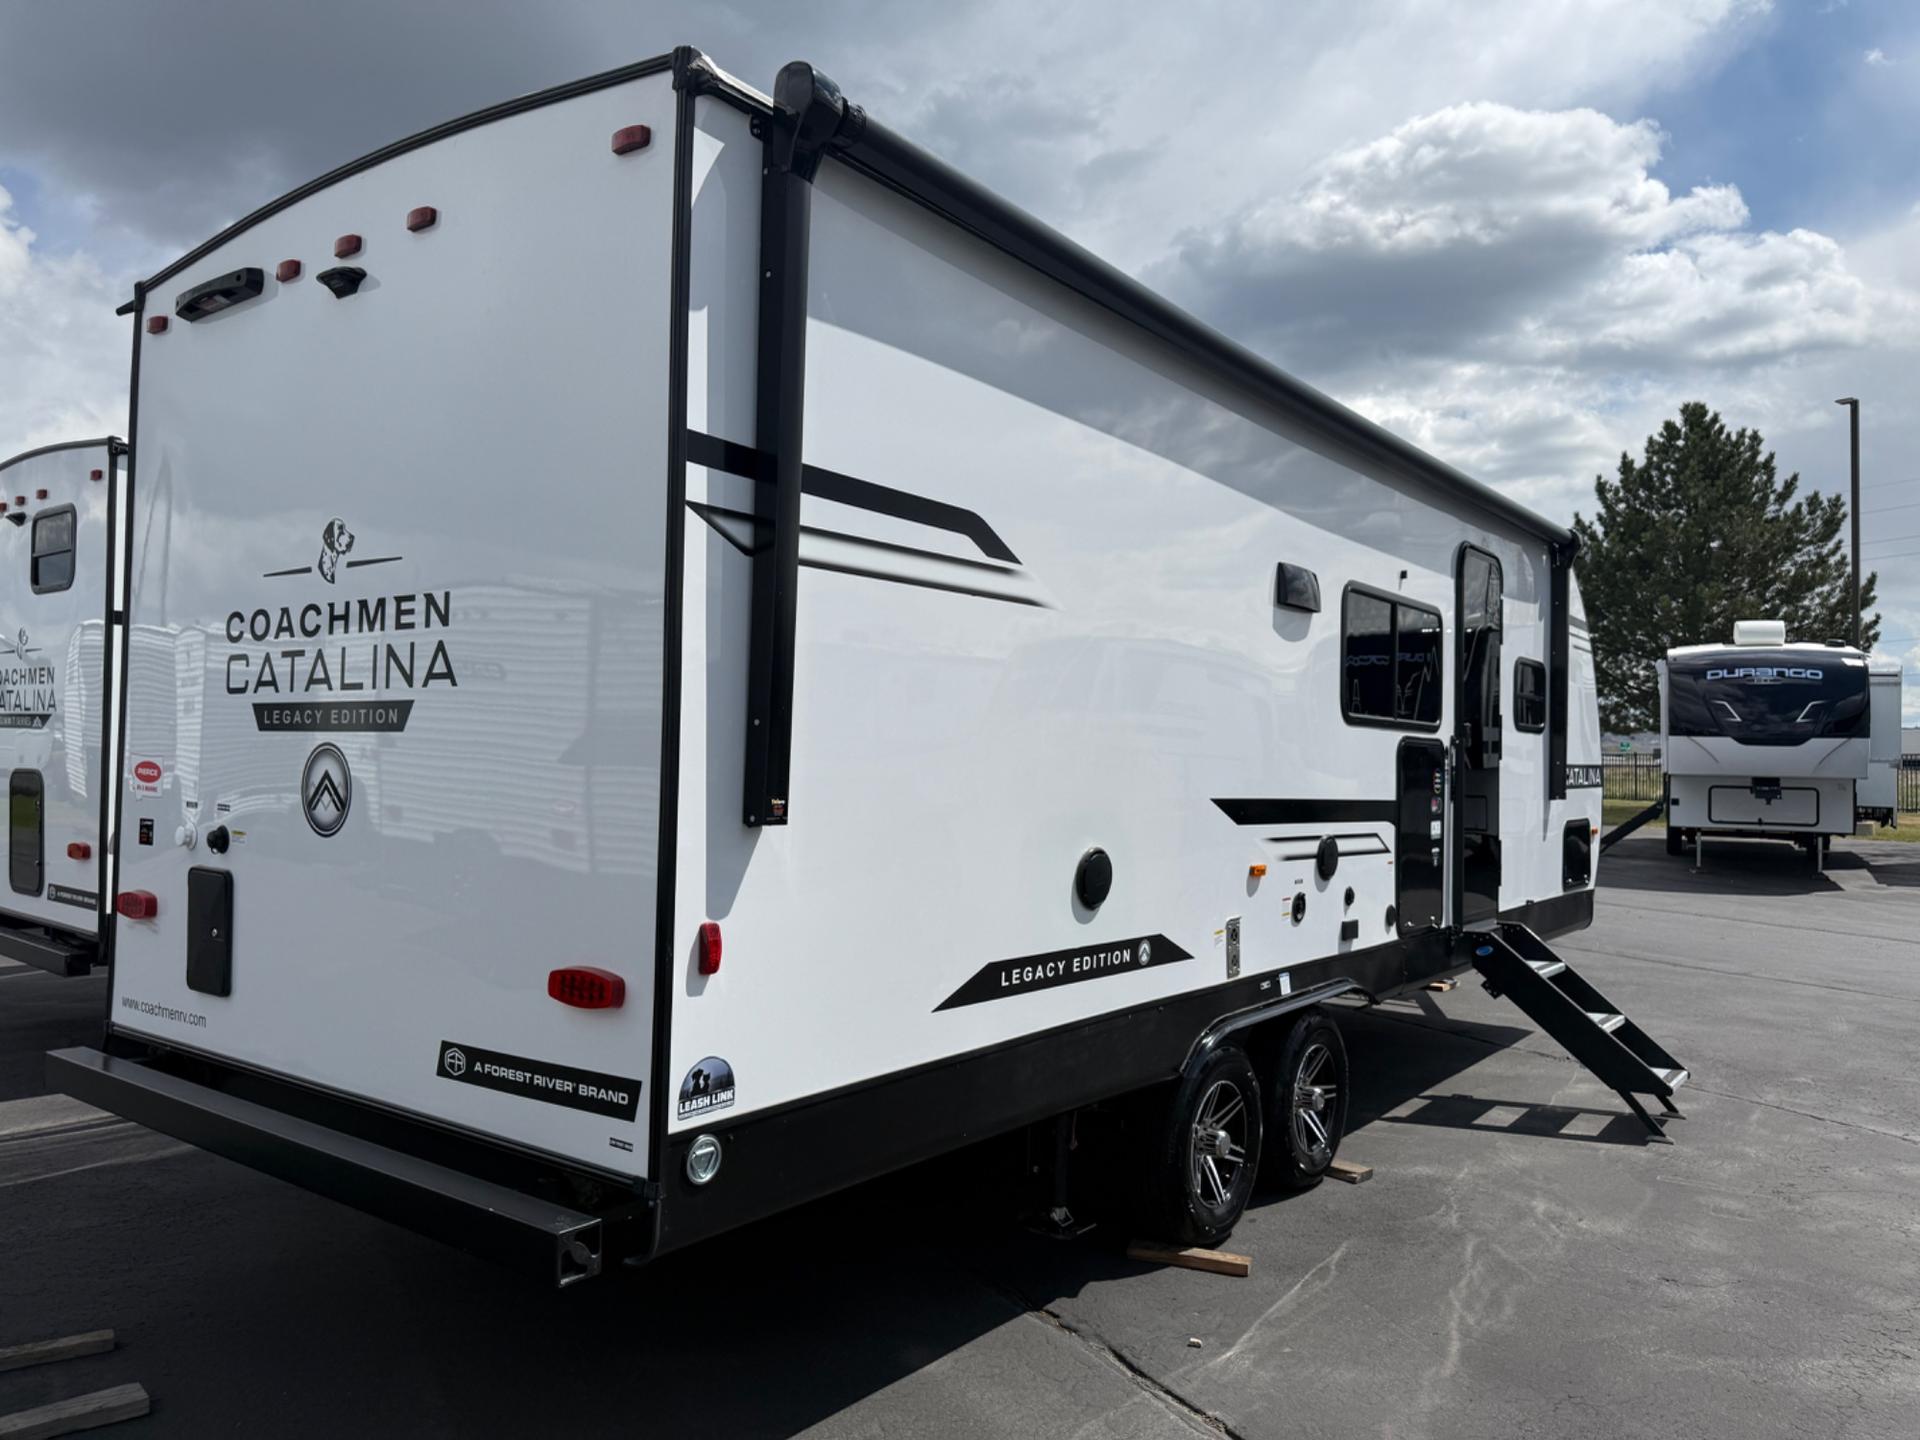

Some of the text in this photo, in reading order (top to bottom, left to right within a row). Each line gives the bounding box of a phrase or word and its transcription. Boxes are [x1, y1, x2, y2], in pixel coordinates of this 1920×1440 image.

[226, 591, 451, 643] COACHMEN
[226, 639, 458, 695] CATALINA
[264, 708, 398, 725] LEGACY EDITION
[1001, 948, 1131, 987] LEGACY EDITION
[122, 997, 207, 1028] www.coachmenrv.com
[473, 1061, 483, 1073] A
[484, 1063, 532, 1084] FOREST
[578, 1083, 629, 1105] BRAND
[680, 1095, 710, 1113] LEASH
[712, 1089, 734, 1104] LINK
